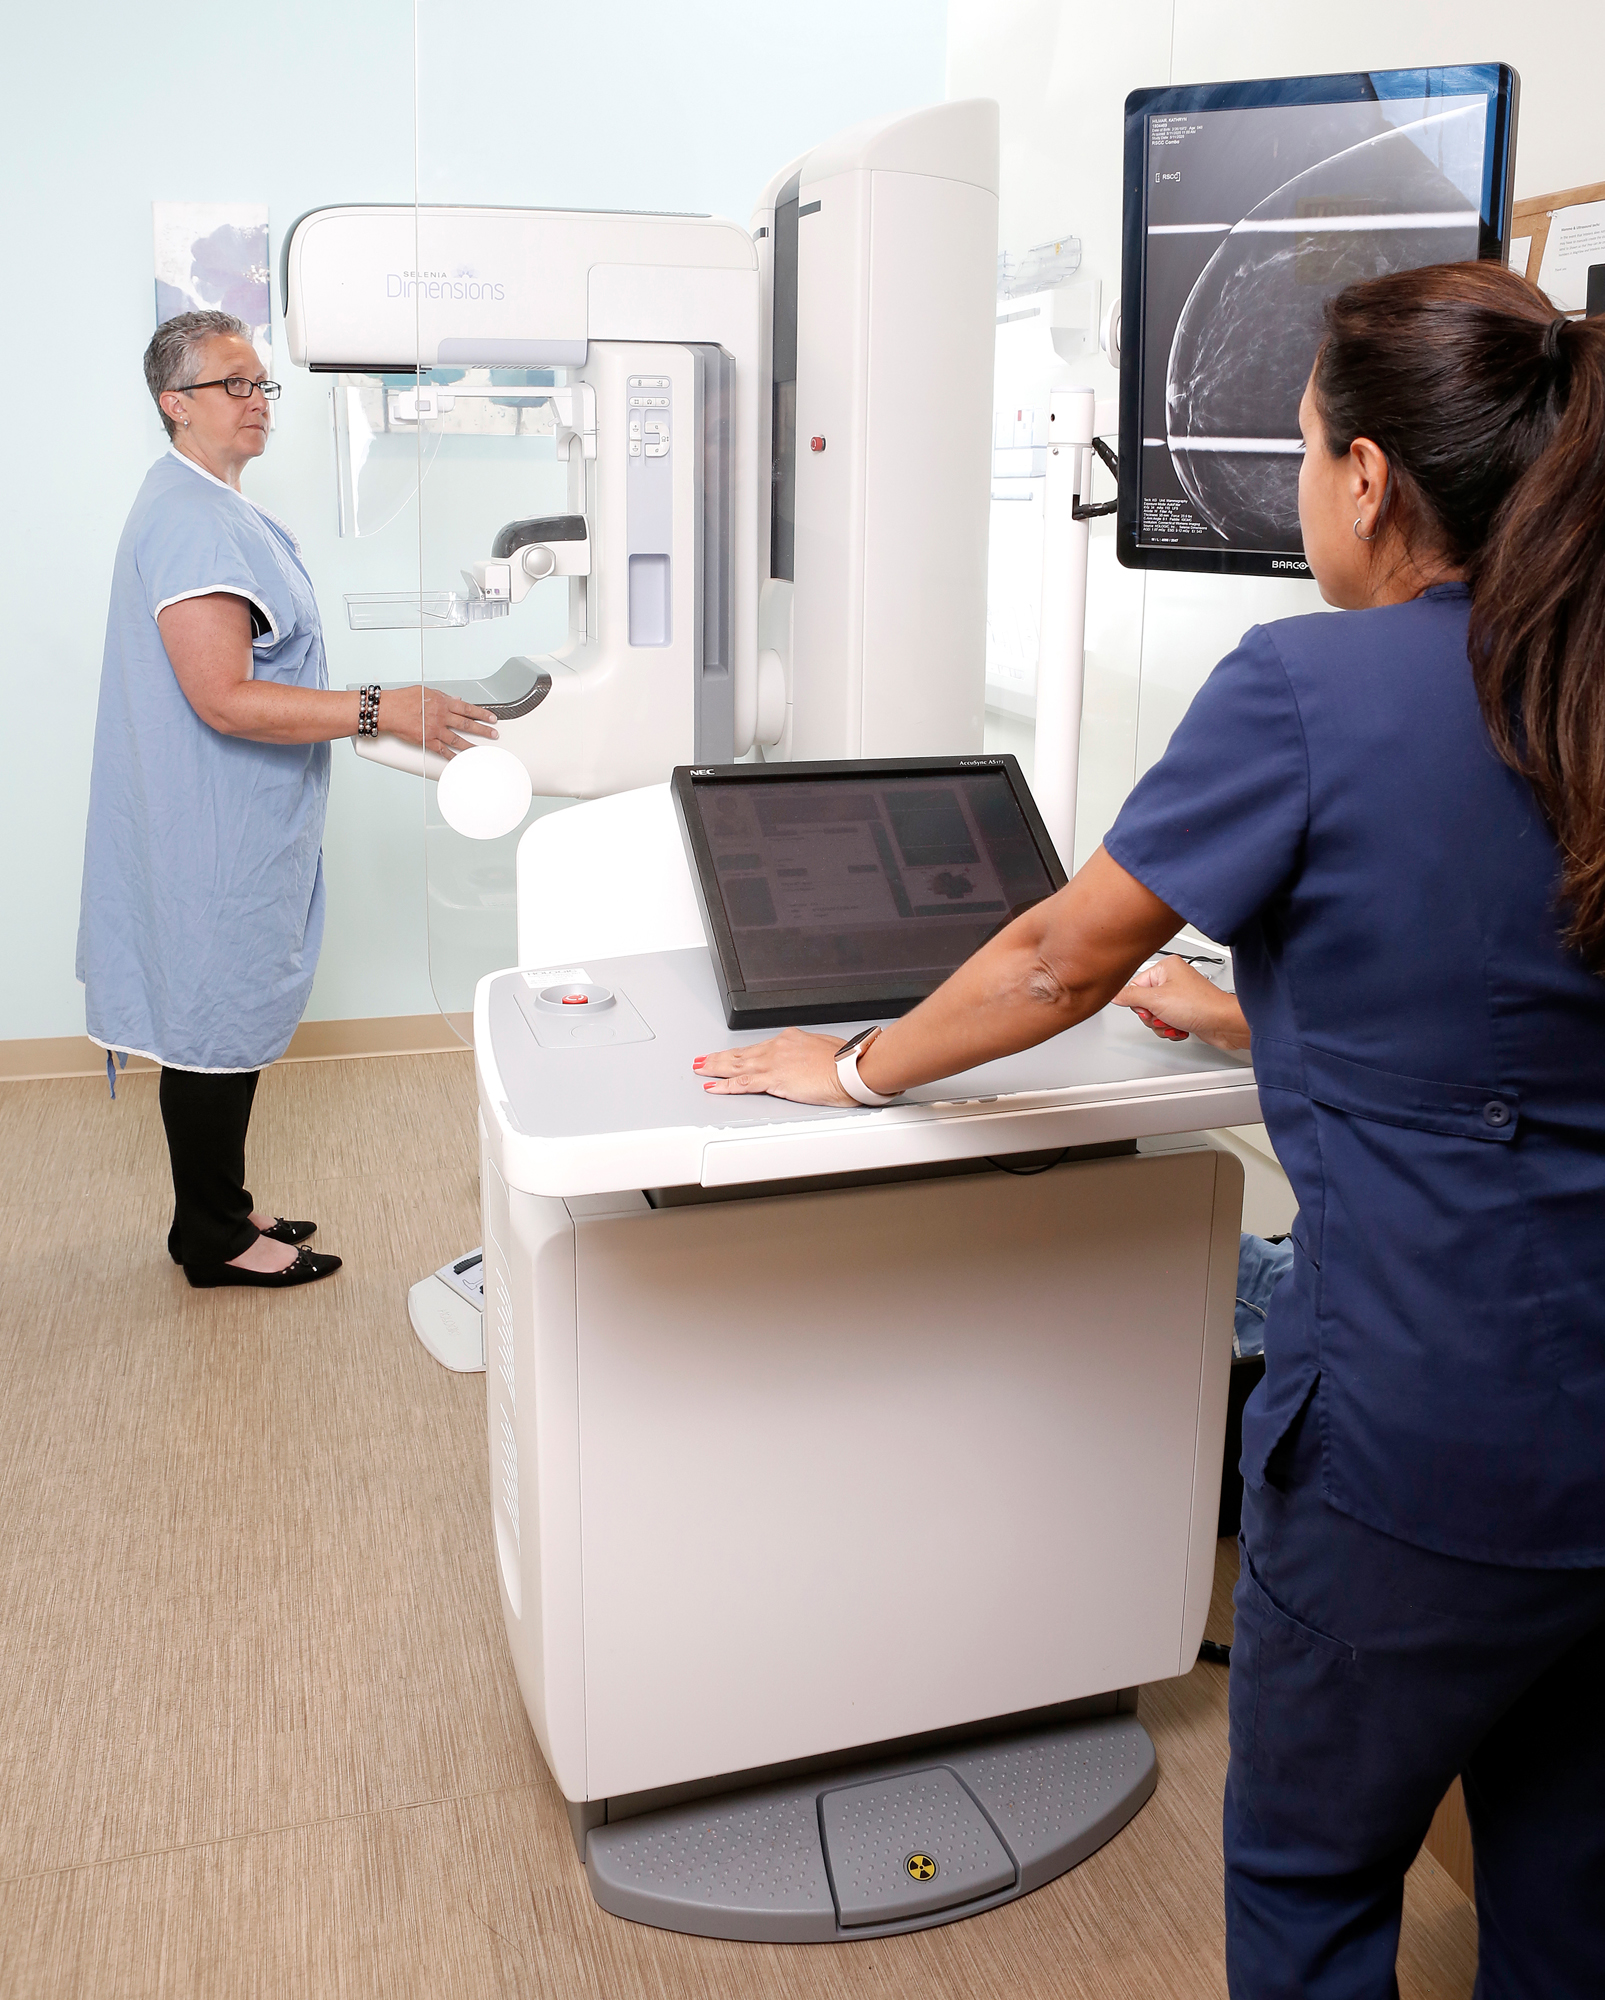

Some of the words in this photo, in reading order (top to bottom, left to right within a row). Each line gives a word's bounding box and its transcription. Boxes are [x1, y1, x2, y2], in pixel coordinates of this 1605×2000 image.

[403, 270, 447, 279] SELENIA
[386, 273, 506, 301] Dimensions
[1271, 560, 1307, 570] BARCO
[689, 768, 715, 776] NEC
